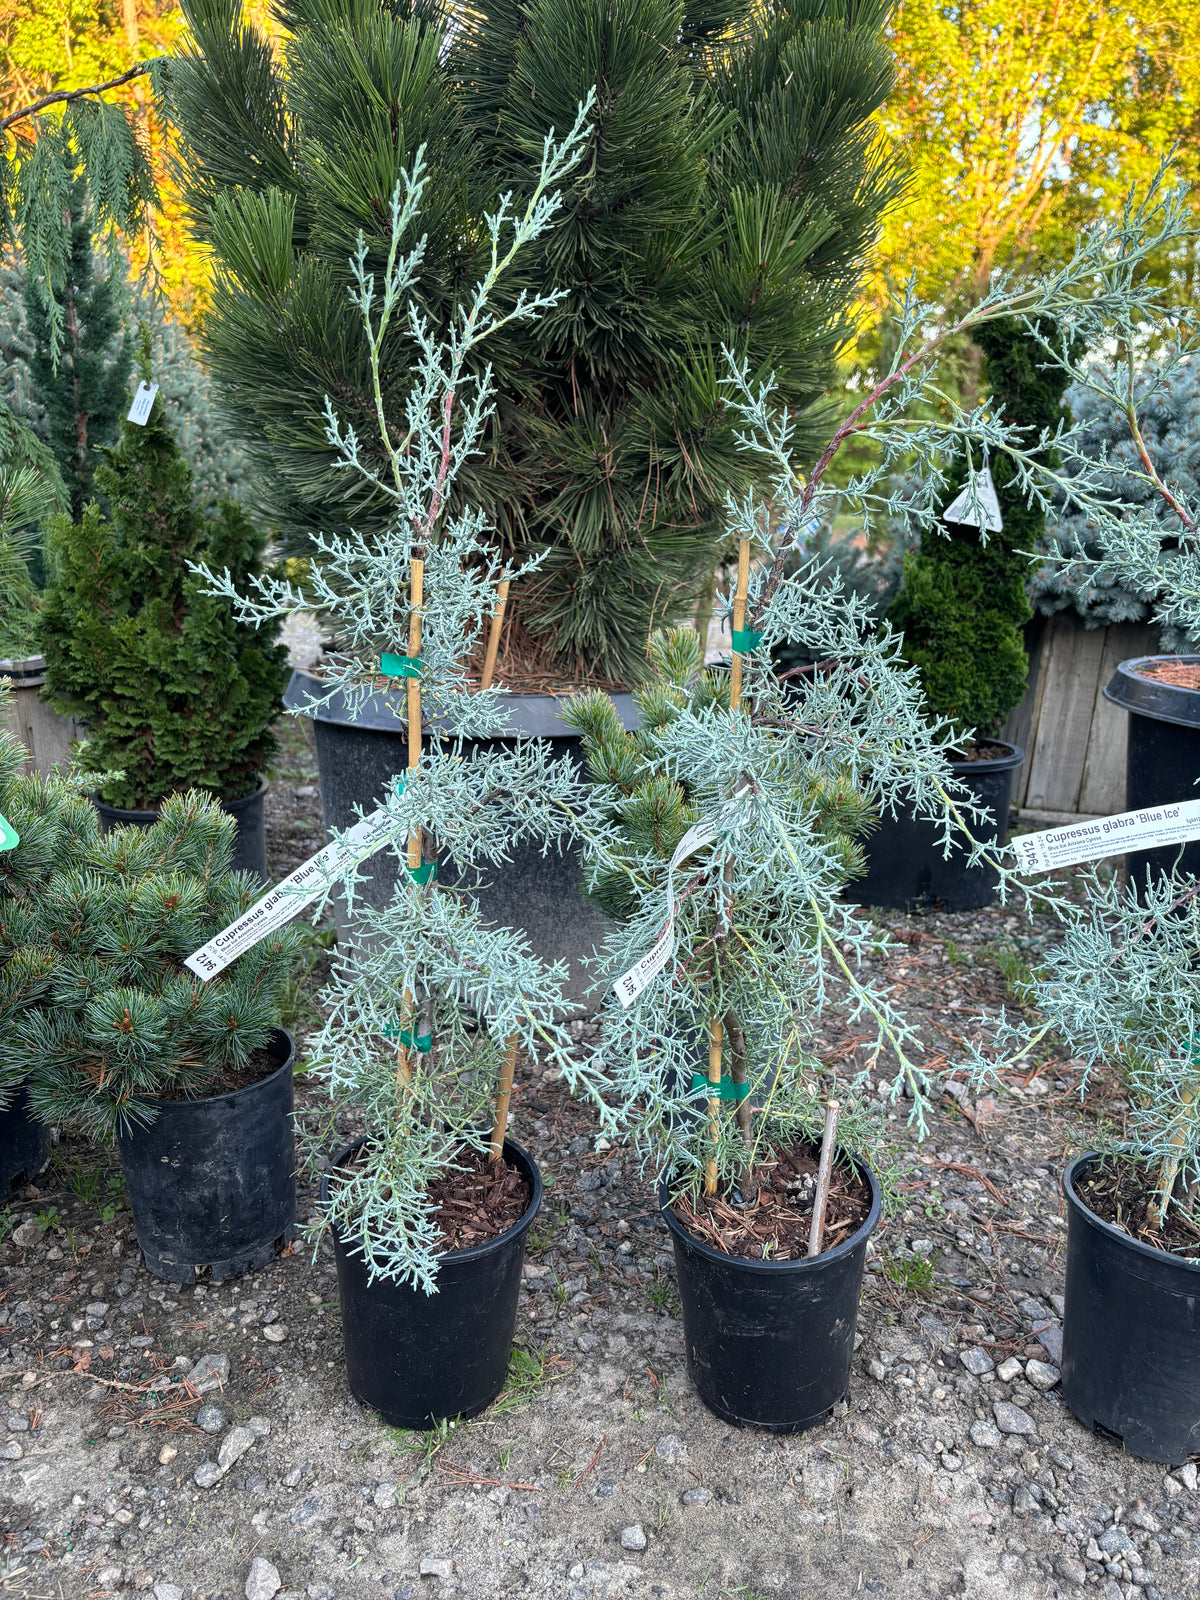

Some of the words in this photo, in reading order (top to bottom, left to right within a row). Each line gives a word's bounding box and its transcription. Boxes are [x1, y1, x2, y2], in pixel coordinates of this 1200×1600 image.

[1045, 826, 1100, 844] Cupressus
[1102, 817, 1135, 833] glabra
[1136, 811, 1162, 824] 'Blue
[1163, 807, 1180, 819] Ice'
[1023, 840, 1038, 866] 9412
[216, 909, 264, 946] Cupressus
[264, 888, 291, 910] glab
[290, 866, 315, 885] 'Blue
[314, 852, 330, 868] Ie'
[196, 953, 216, 971] 9412
[623, 976, 636, 996] 9412
